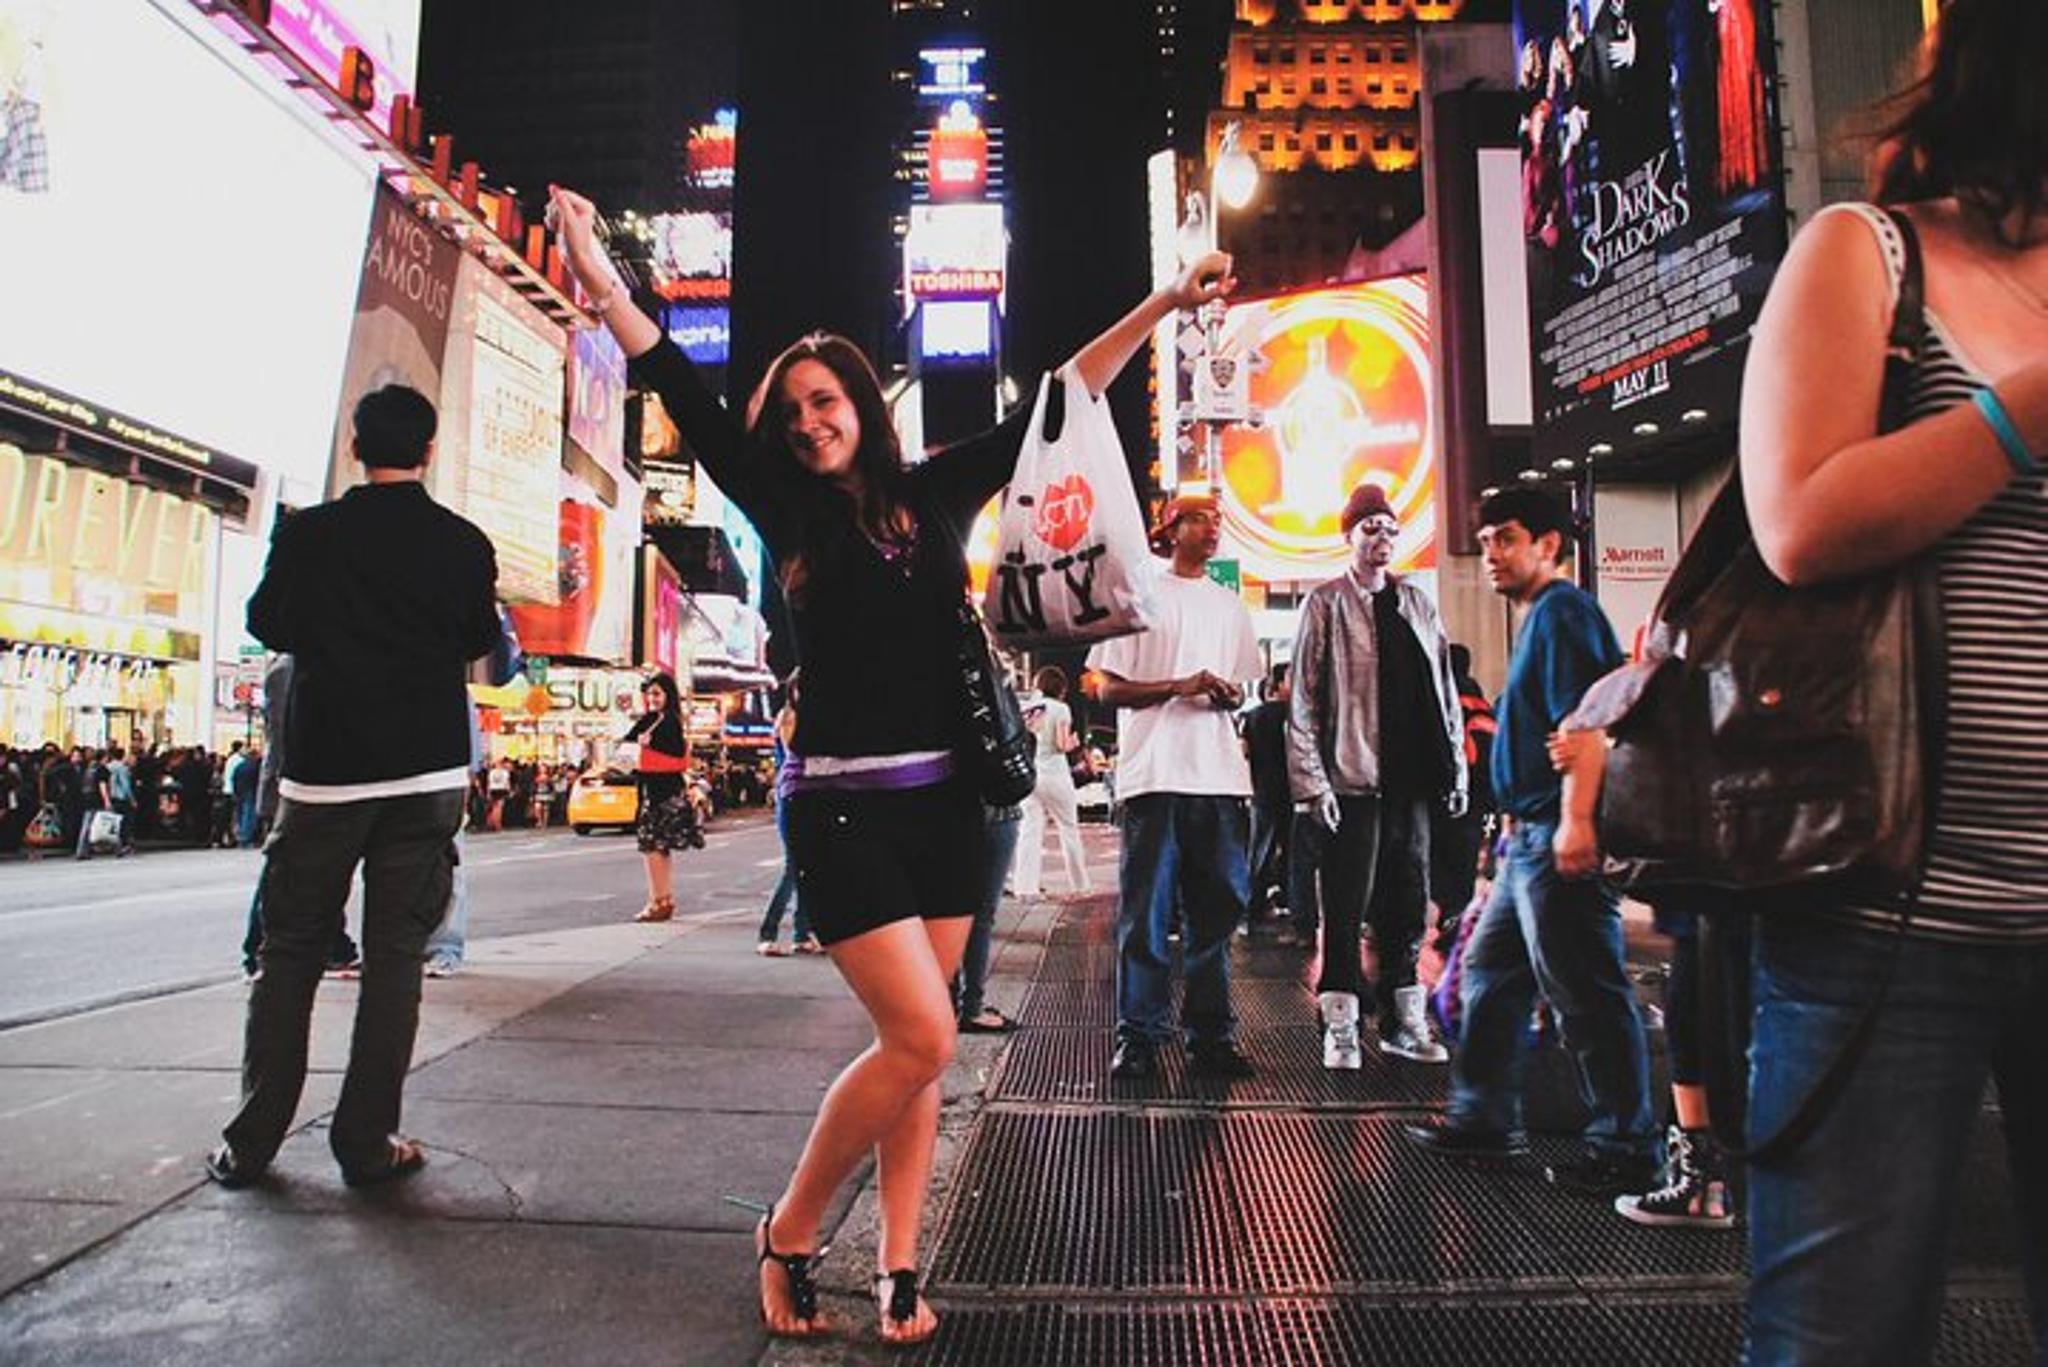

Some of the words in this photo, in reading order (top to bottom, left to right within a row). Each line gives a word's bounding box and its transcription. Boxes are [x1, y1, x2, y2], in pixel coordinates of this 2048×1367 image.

[911, 271, 1000, 291] TOSHIBA
[1613, 366, 1650, 401] MAY
[996, 544, 1110, 634] NY
